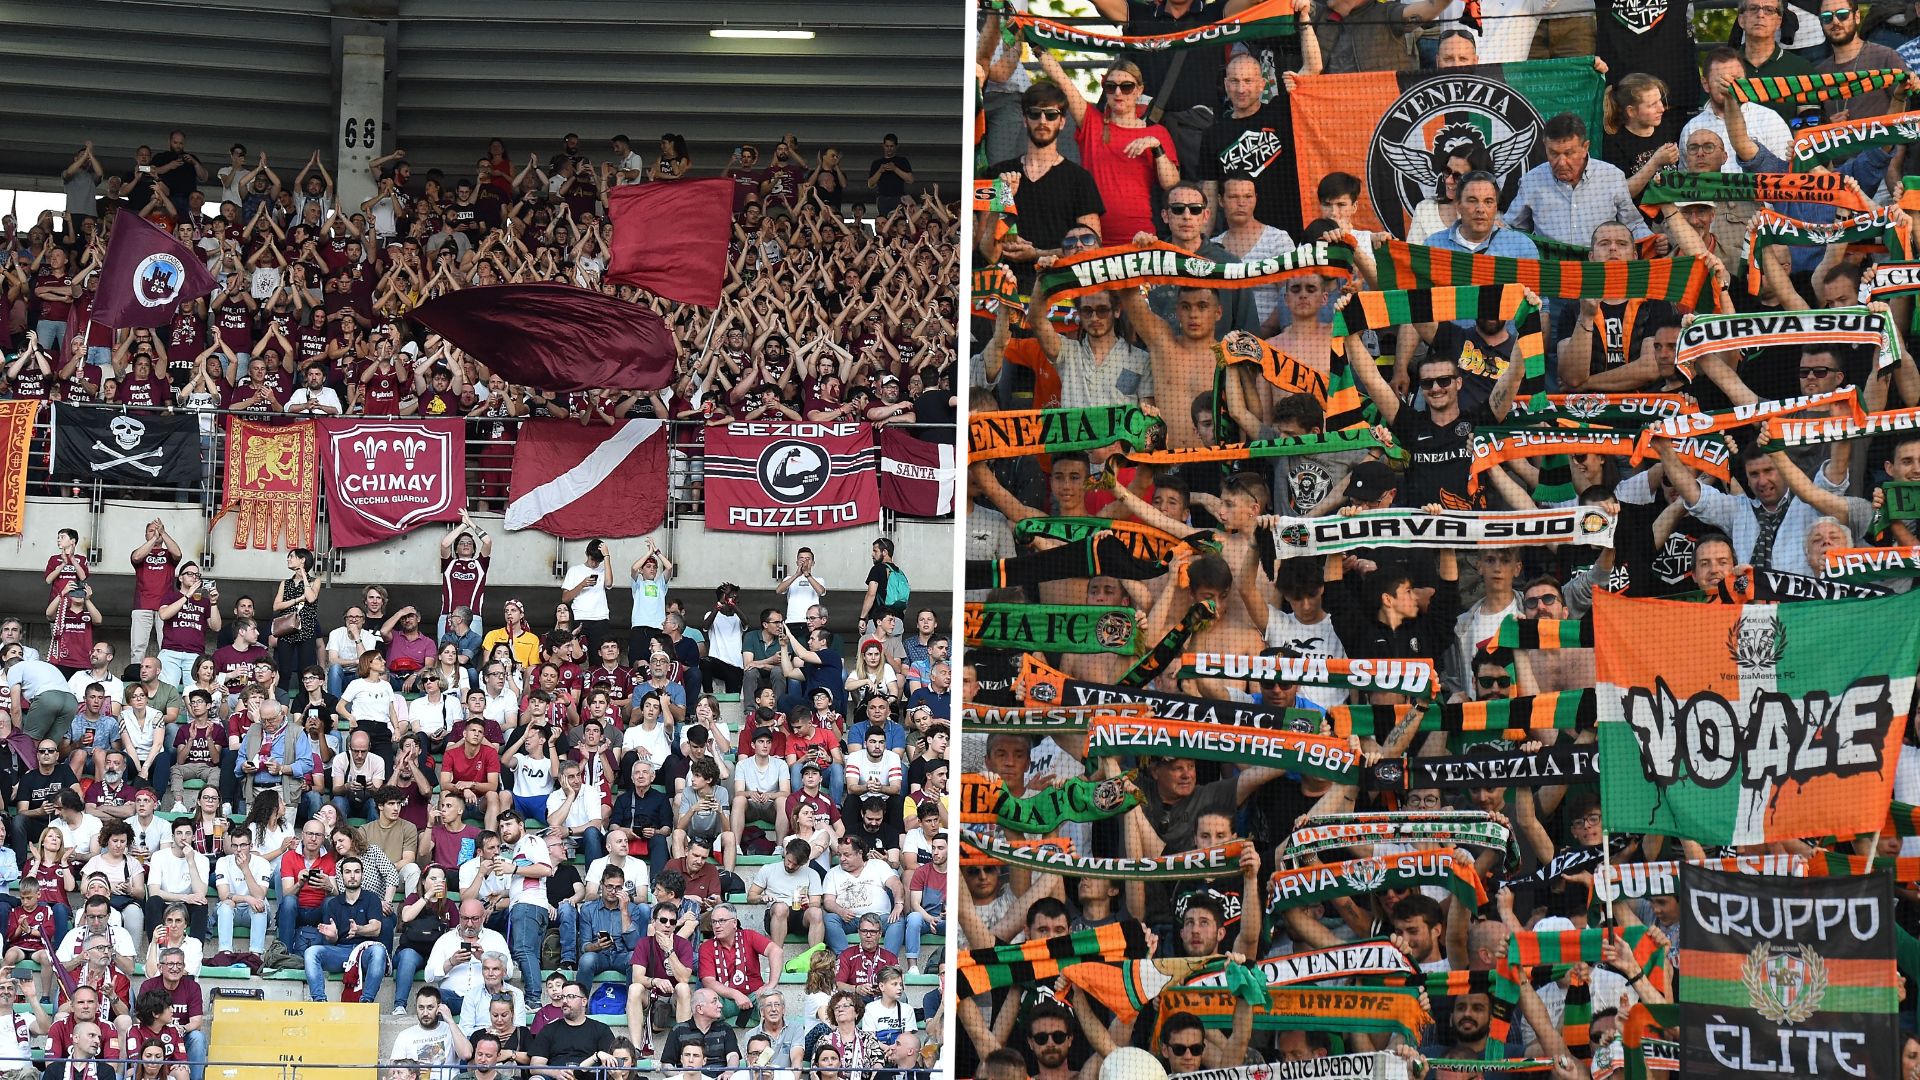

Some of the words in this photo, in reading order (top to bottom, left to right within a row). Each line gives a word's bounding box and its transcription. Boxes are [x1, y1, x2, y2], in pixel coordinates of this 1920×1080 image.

[1391, 82, 1509, 124] VENEZIA
[345, 117, 376, 149] 68
[1794, 121, 1889, 161] CURVA
[1220, 132, 1279, 164] VENEZIA
[1223, 141, 1282, 174] MESTRE
[1713, 188, 1834, 202] ANNIVERSARIO
[457, 211, 474, 219] KITH
[1854, 205, 1897, 232] SU
[1071, 250, 1178, 287] VENEZIA
[1224, 241, 1329, 280] MESTRE
[1685, 315, 1810, 347] CURVA
[1814, 315, 1886, 332] SUD
[304, 342, 322, 350] FORTE
[1620, 398, 1682, 419] SUD
[728, 422, 861, 437] SEZIONE
[968, 413, 1098, 452] ENEZIA
[1107, 406, 1144, 437] FC
[344, 473, 437, 493] CHIMAY
[895, 463, 935, 480] SANTA
[353, 496, 390, 505] VECCHIA
[392, 494, 429, 505] GUARDIA
[729, 501, 859, 527] POZZETTO
[1315, 517, 1468, 542] CURVA
[1484, 516, 1575, 538] SUD
[1820, 549, 1904, 579] URVA
[66, 622, 86, 630] gabrielli
[178, 612, 200, 621] FORTE
[1047, 613, 1090, 645] FC
[978, 679, 1008, 691] NEZIA
[1195, 652, 1329, 683] CURVA
[1347, 658, 1431, 693] SUD
[1720, 671, 1782, 682] VeneziaMestre
[1784, 671, 1796, 680] FC
[963, 707, 1139, 726] AMESTRE
[1073, 685, 1224, 724] VENEZIA
[1233, 707, 1275, 731] FC
[1089, 724, 1171, 748] NEZIA
[1179, 729, 1286, 760] MESTRE
[1293, 741, 1355, 774] 1987
[521, 766, 544, 778] FILA
[1029, 755, 1051, 773] HH
[1425, 752, 1563, 783] VENEZIA
[1051, 779, 1089, 814] FC
[963, 829, 1228, 872] NEZIAMESTRE
[1397, 854, 1453, 878] SUD
[1689, 889, 1880, 942] GRUPPO
[1286, 947, 1400, 980] VENEZIA
[279, 1054, 295, 1062] FILA
[298, 1055, 303, 1063] 4
